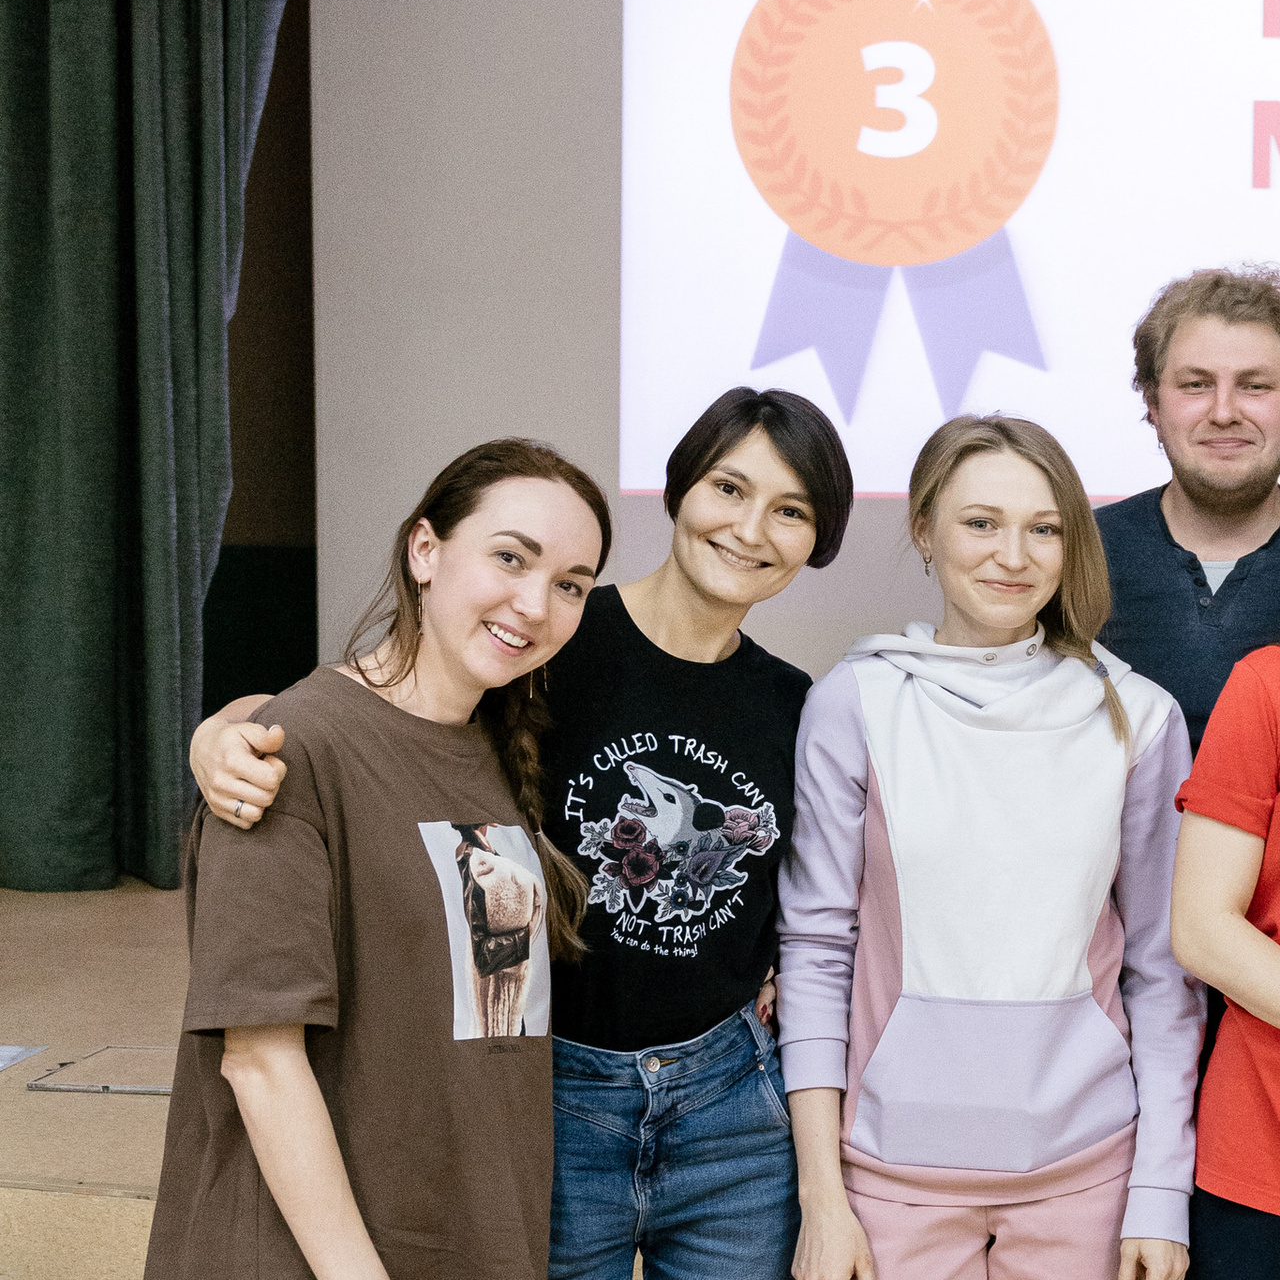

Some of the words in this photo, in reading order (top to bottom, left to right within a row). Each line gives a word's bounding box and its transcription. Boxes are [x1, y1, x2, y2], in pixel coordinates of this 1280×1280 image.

[855, 41, 940, 158] 3
[593, 732, 658, 771] CALLED
[668, 734, 728, 773] TRASH
[731, 772, 765, 807] CAN
[616, 911, 652, 935] NOT
[658, 922, 706, 945] TRASH
[709, 890, 744, 931] CAN'T
[640, 940, 650, 951] do
[653, 944, 669, 956] the
[672, 943, 698, 958] thing!
